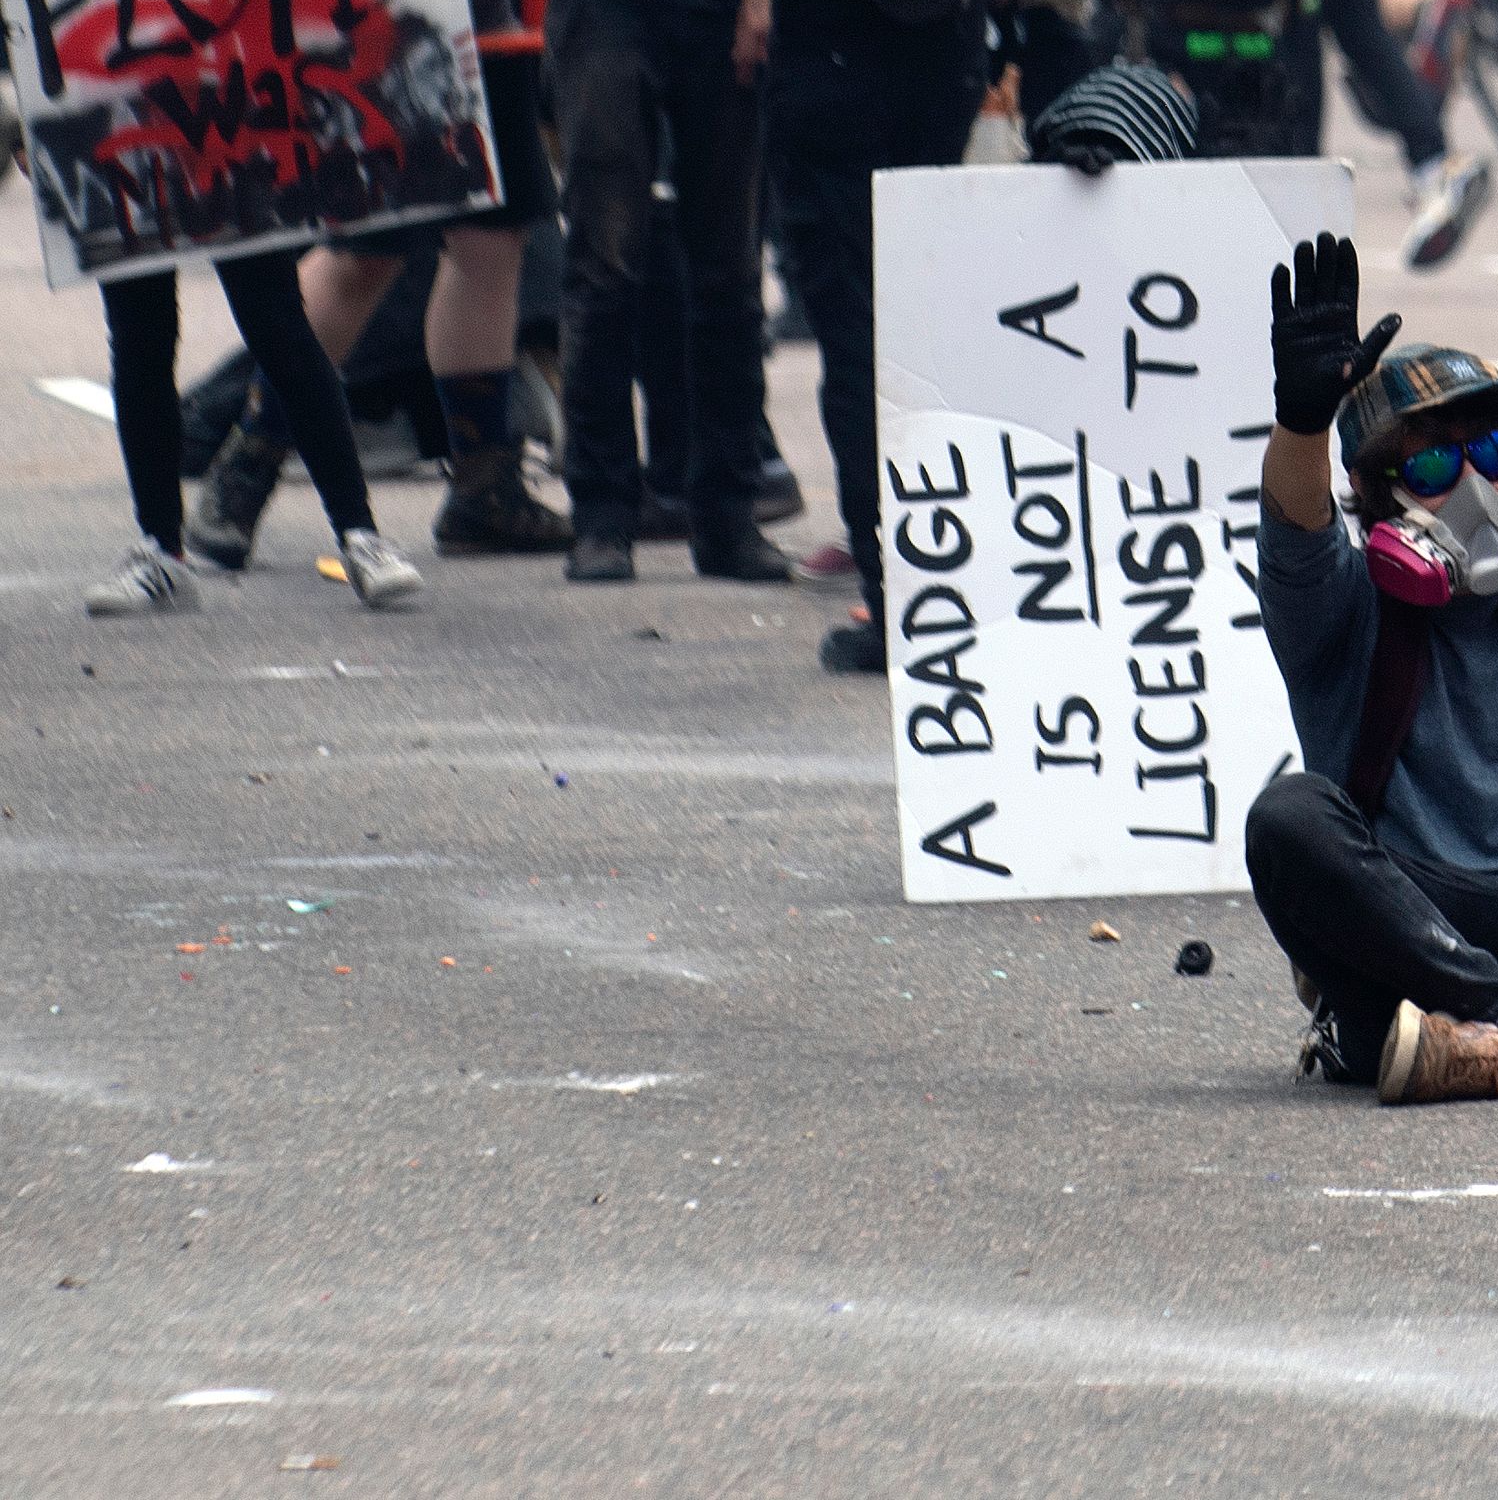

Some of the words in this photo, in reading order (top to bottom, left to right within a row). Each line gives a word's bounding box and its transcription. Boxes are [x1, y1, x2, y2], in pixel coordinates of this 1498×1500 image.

[997, 281, 1086, 360] A
[1122, 271, 1200, 412] TO
[1000, 431, 1086, 622] NOT
[886, 440, 994, 756] BADGE
[1117, 455, 1217, 843] LICENSE
[1034, 694, 1102, 777] IS
[921, 800, 1013, 877] A
